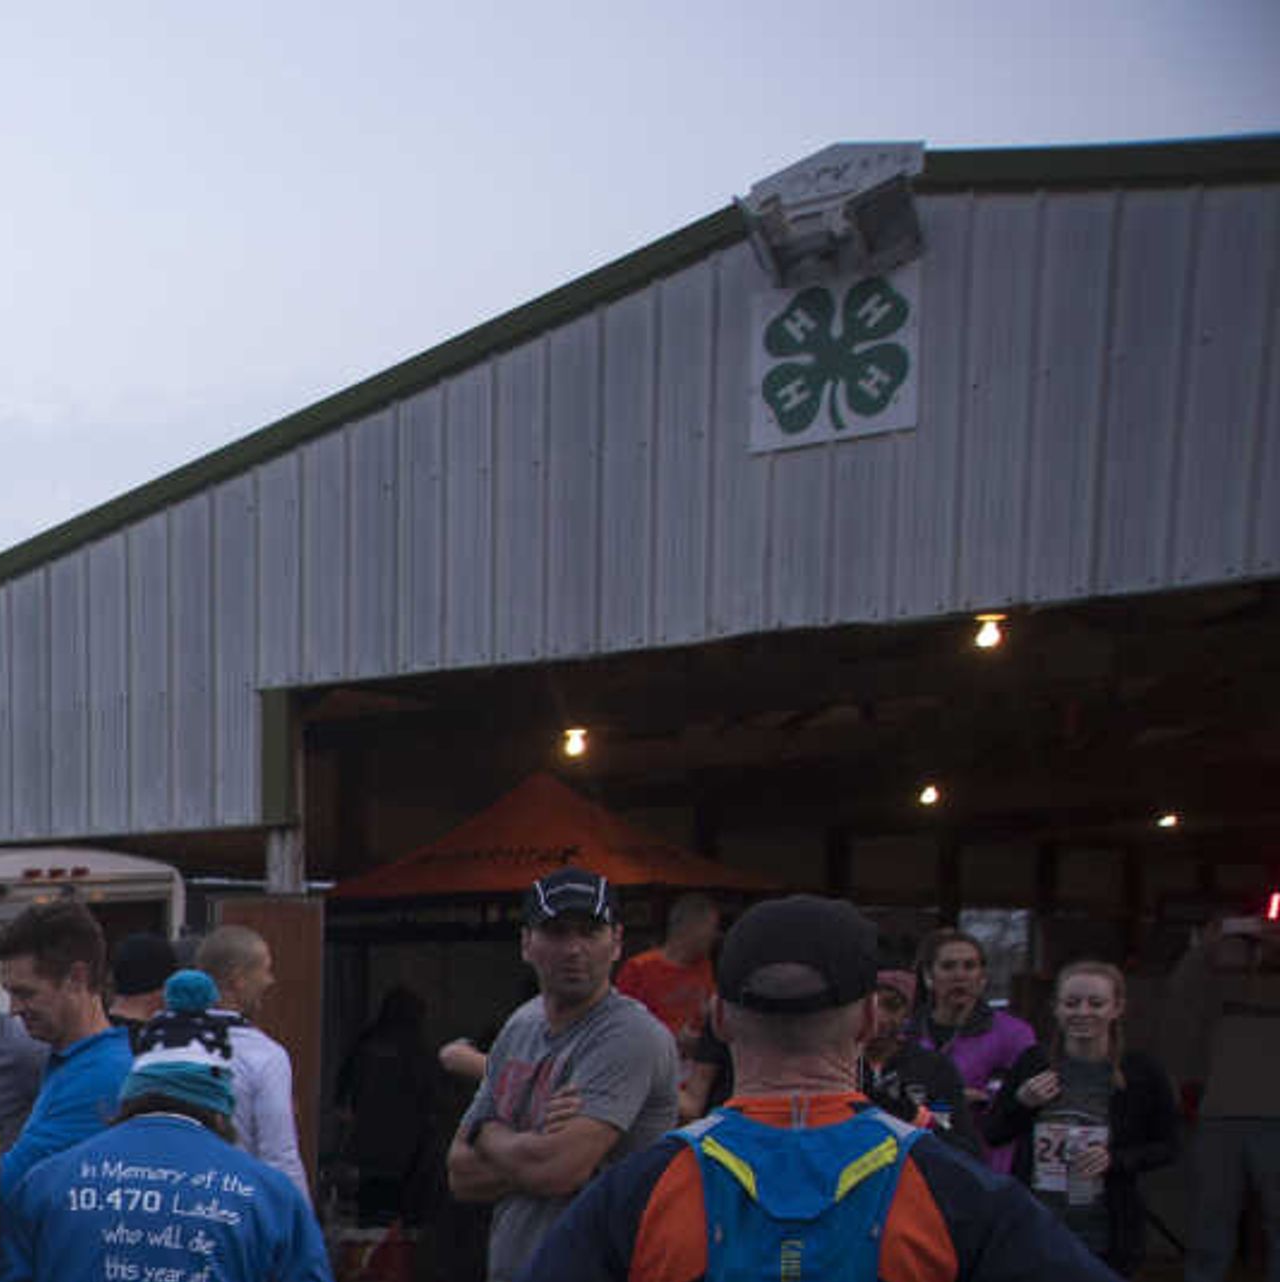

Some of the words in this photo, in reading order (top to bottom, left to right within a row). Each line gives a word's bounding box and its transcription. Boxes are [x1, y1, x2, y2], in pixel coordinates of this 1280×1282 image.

[81, 1162, 96, 1179] In
[101, 1160, 186, 1184] Memory
[190, 1170, 218, 1190] of
[223, 1174, 255, 1196] the
[173, 1193, 241, 1225] Ladies
[103, 1221, 142, 1245] who
[148, 1223, 184, 1249] will
[188, 1230, 217, 1255] die
[105, 1256, 140, 1281] this
